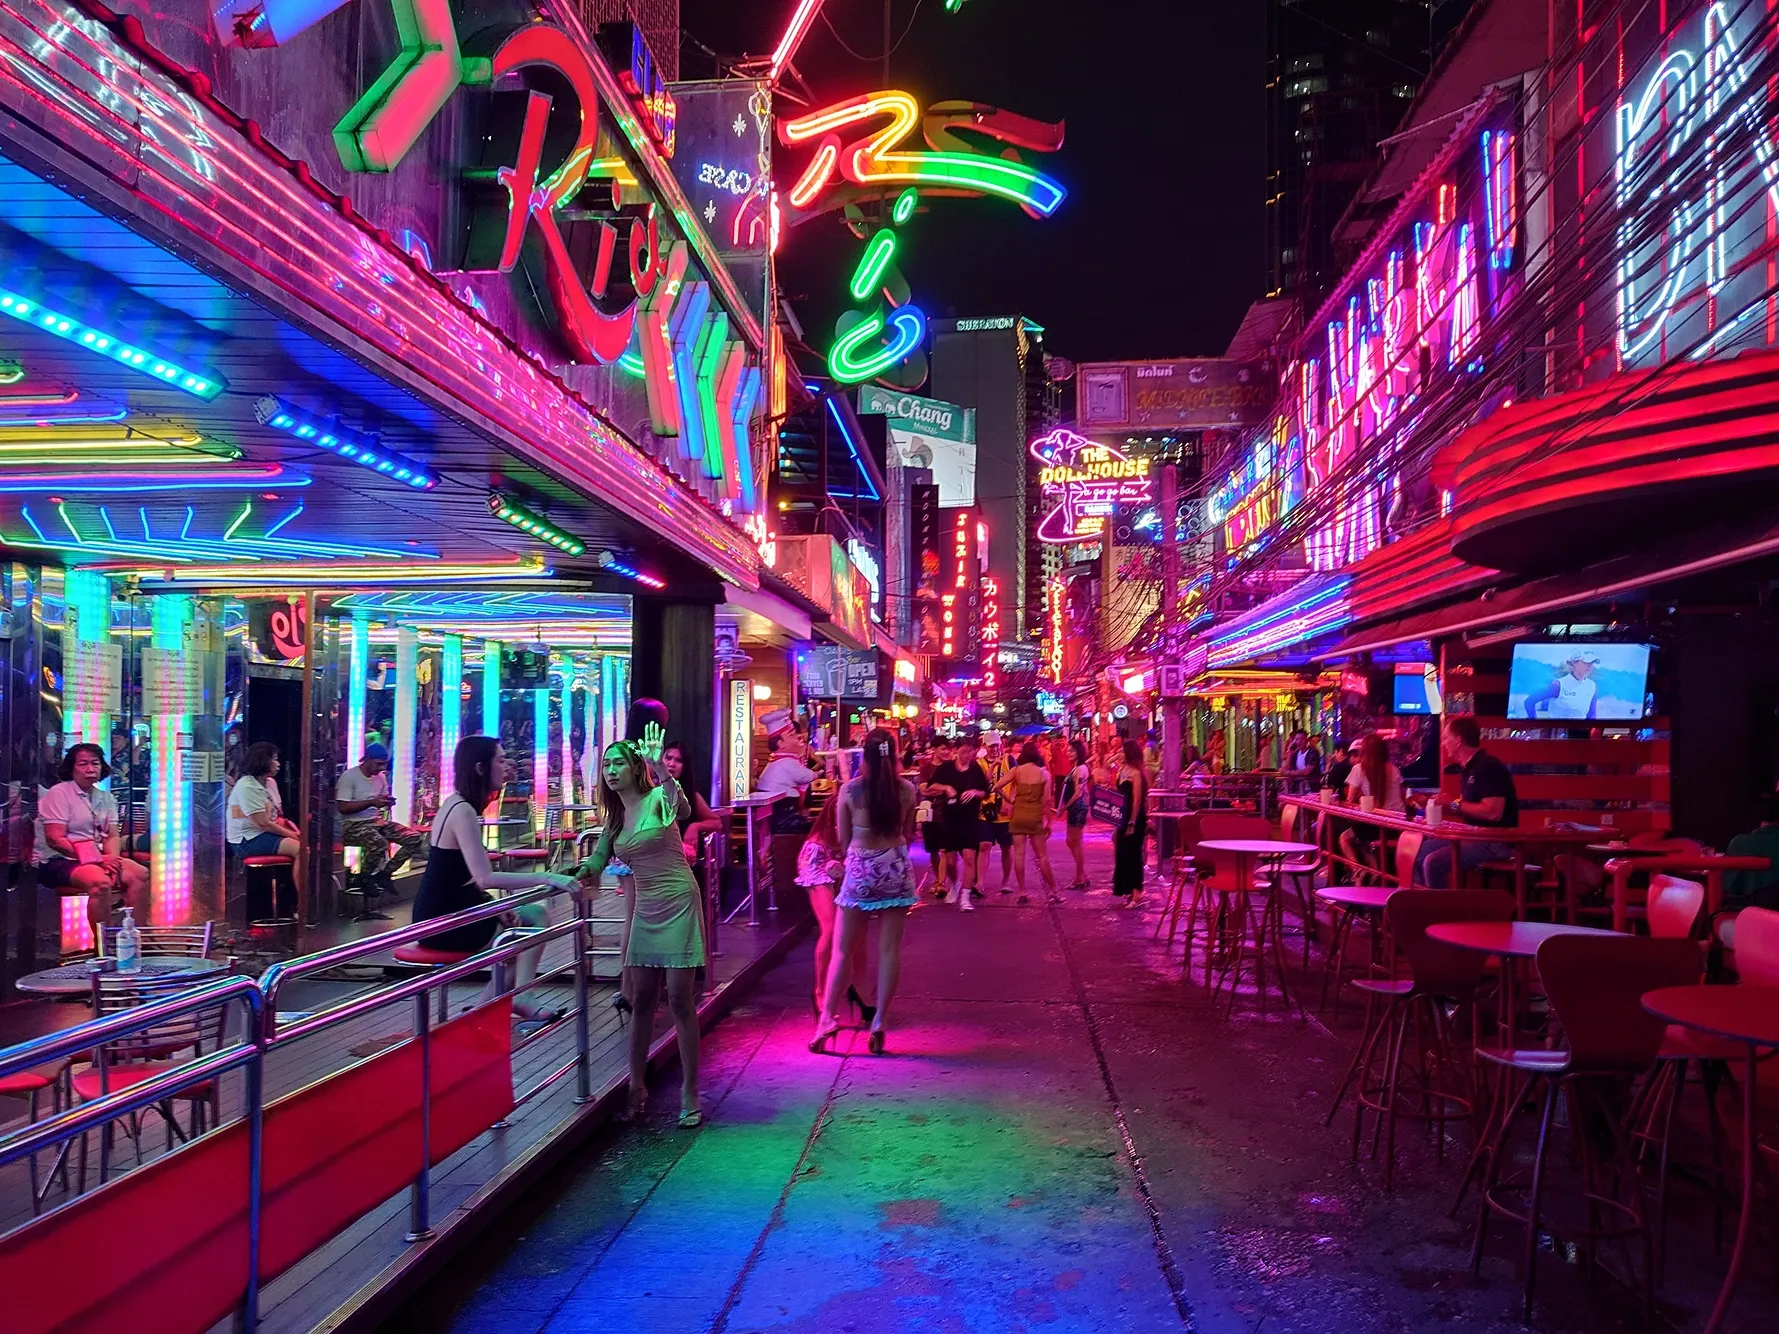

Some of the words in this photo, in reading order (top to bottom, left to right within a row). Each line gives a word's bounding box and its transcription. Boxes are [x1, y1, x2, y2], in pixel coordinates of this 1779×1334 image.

[897, 397, 952, 431] Chang
[1081, 446, 1110, 463] THE
[1120, 485, 1138, 496] bar
[955, 513, 968, 589] SUZIE
[941, 594, 956, 656] WONG
[847, 661, 876, 678] OPEN
[734, 681, 746, 800] RESTAURAN
